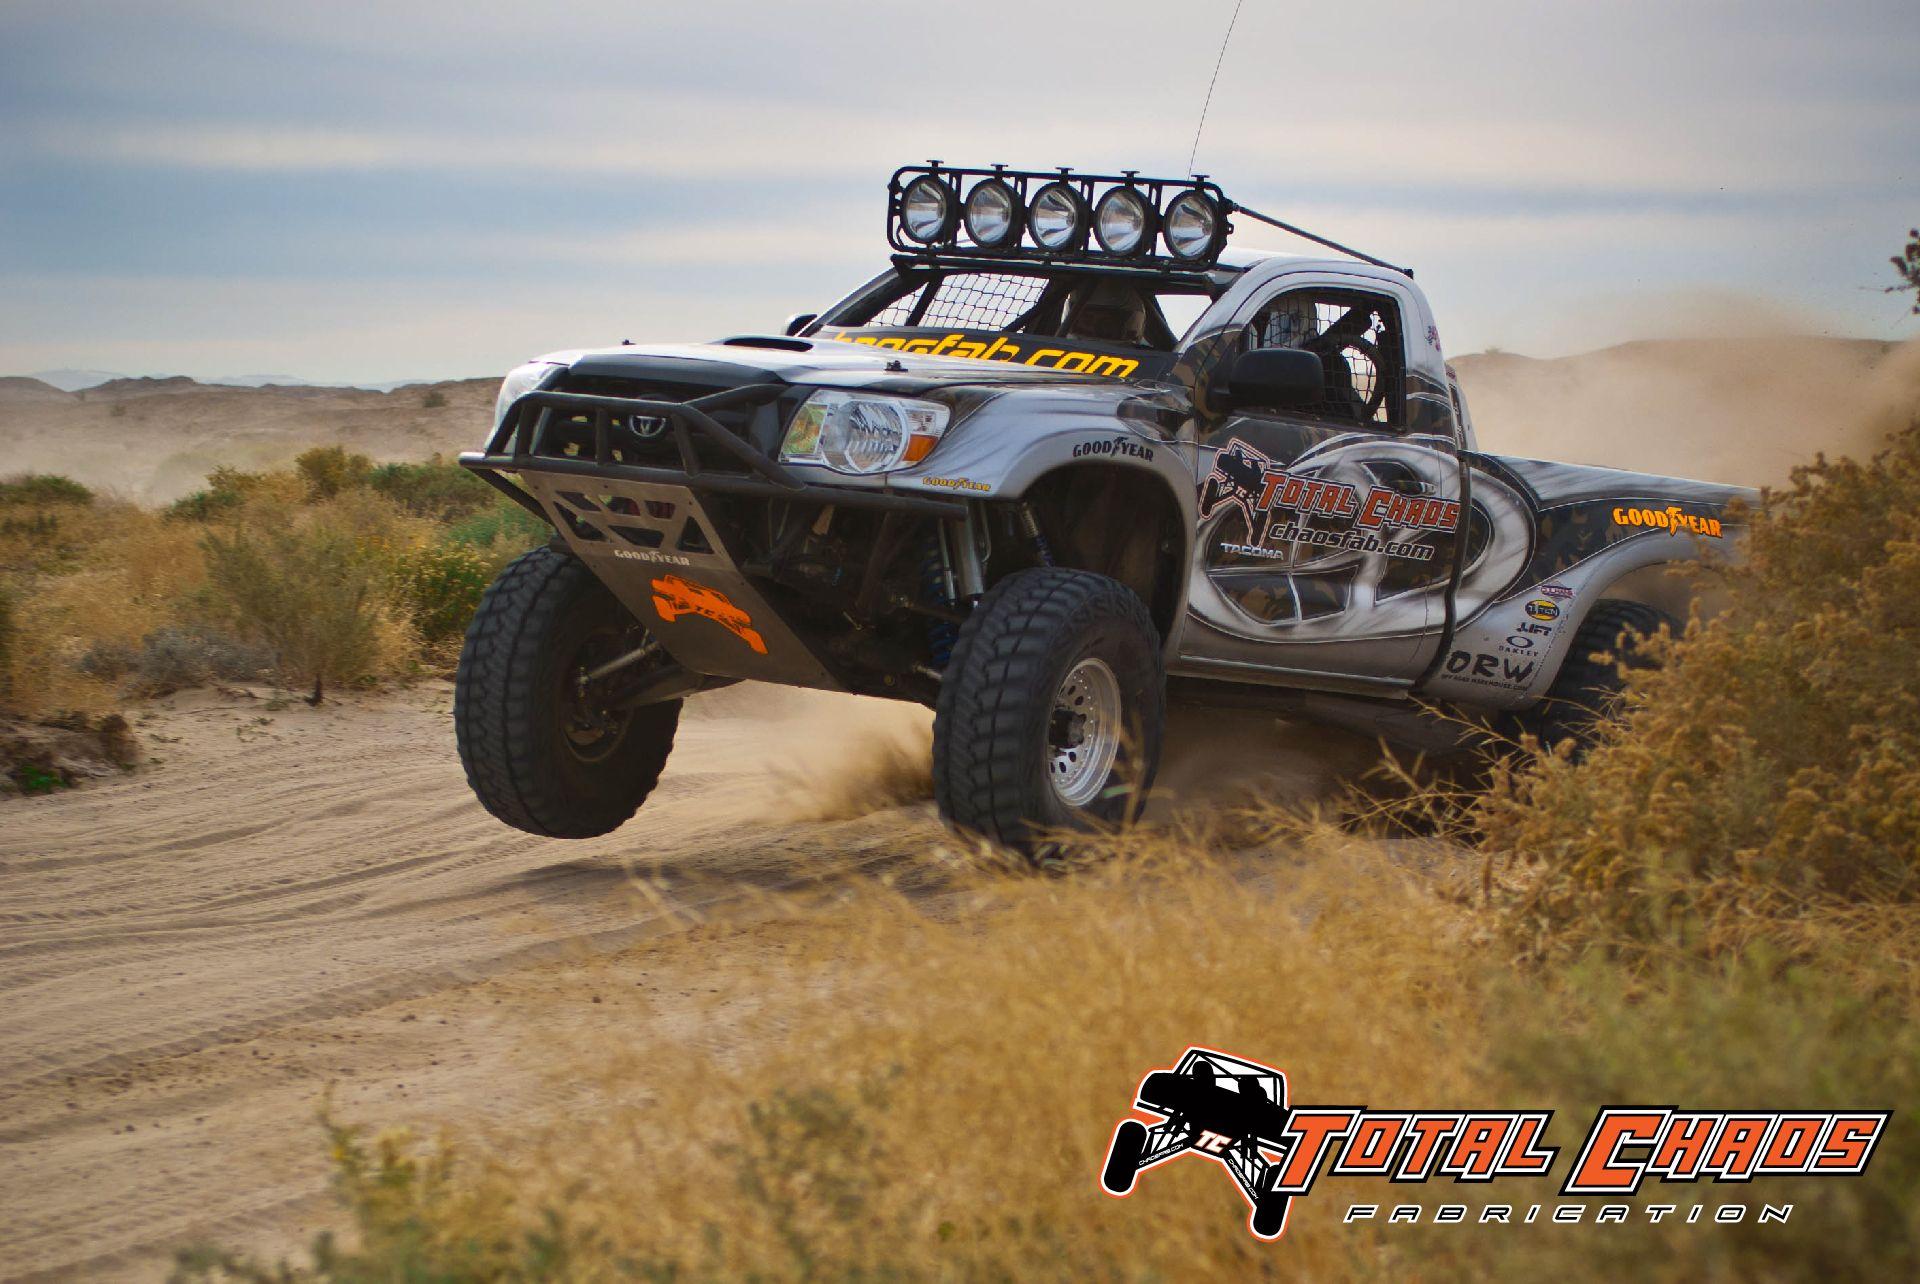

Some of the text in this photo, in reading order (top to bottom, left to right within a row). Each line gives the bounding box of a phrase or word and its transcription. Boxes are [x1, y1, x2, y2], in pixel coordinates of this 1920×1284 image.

[1072, 436, 1154, 462] GOODYEAR
[923, 476, 991, 491] GOODYEAR
[1256, 470, 1460, 533] TOTAL CHAOS
[1612, 506, 1723, 538] GOODYEAR
[1220, 543, 1283, 560] TACOMA
[1269, 521, 1434, 560] chaosfab.com
[613, 550, 690, 565] GOODYEAR
[1447, 650, 1535, 683] ORW
